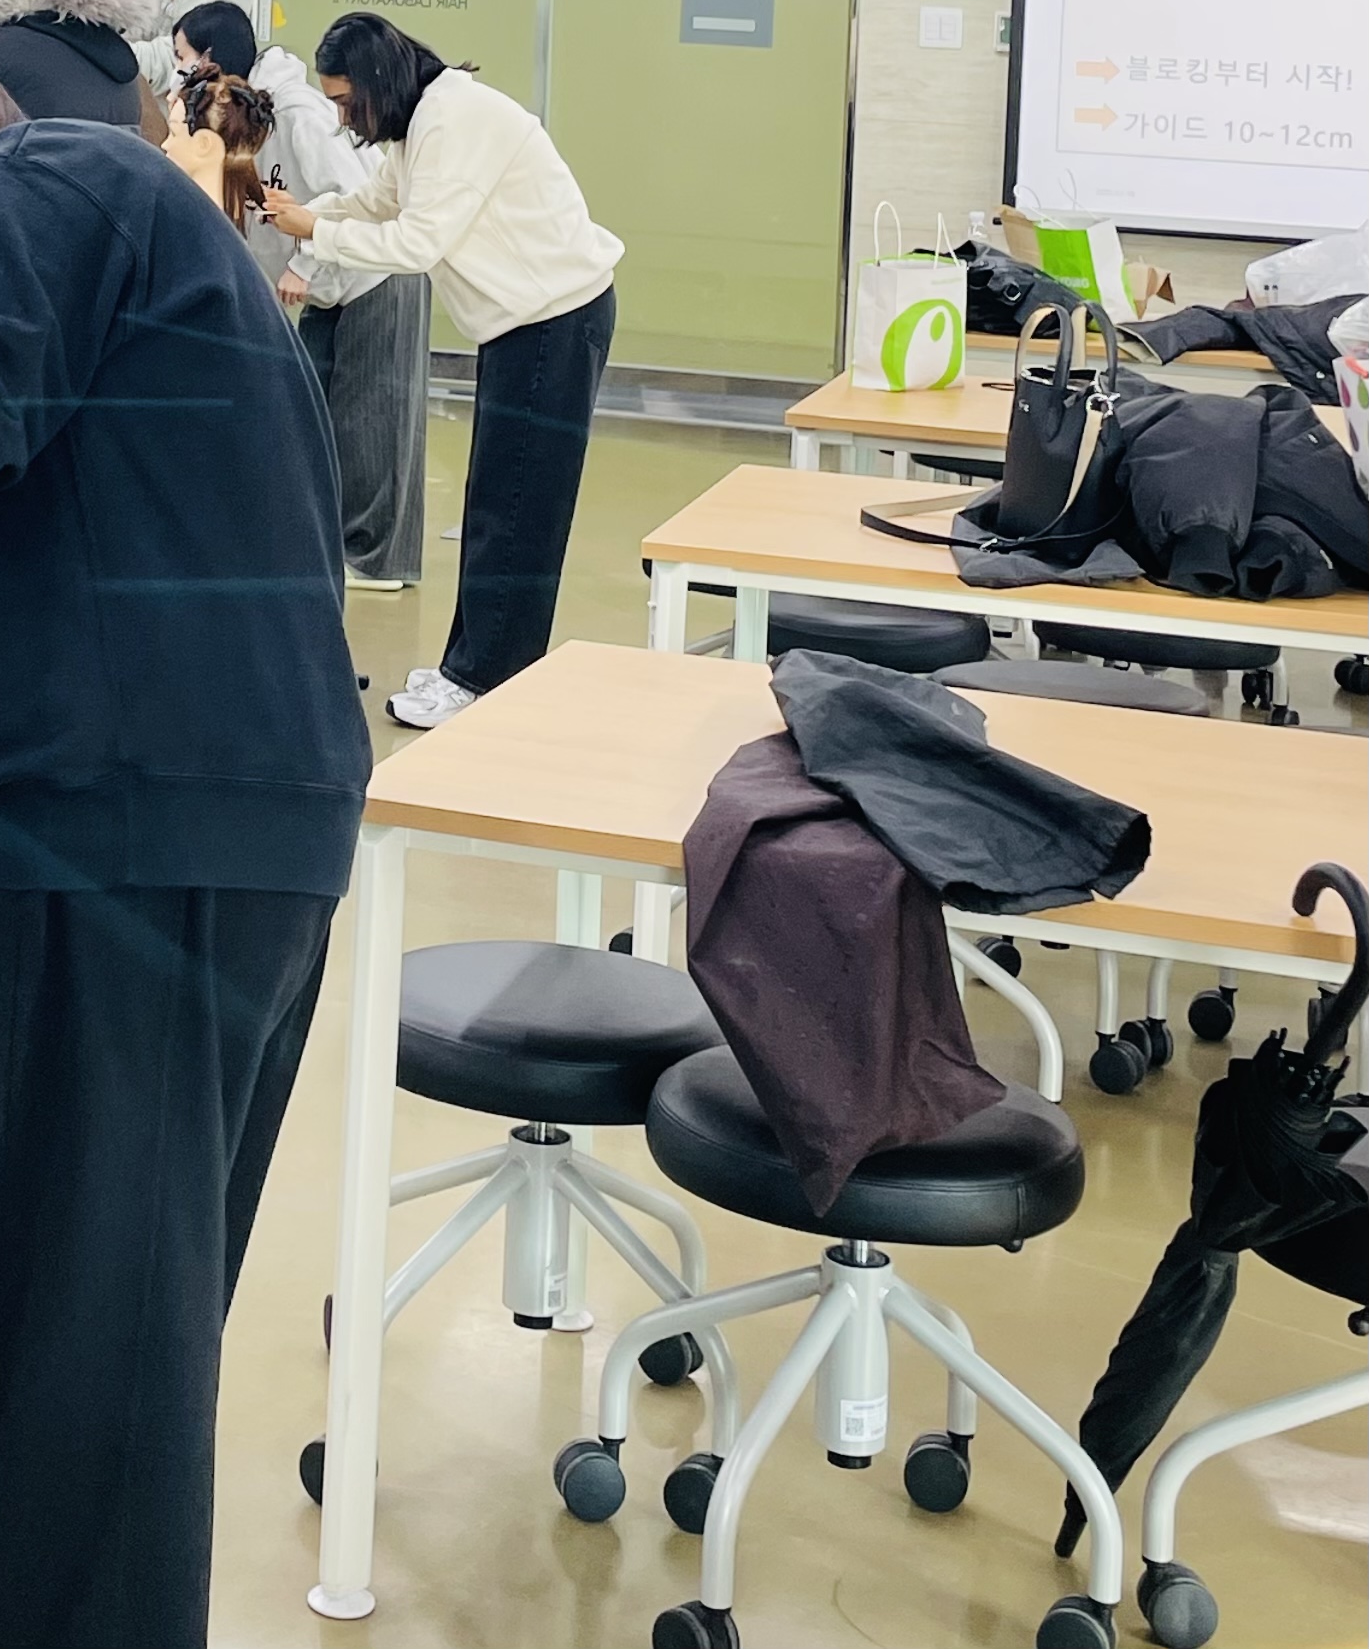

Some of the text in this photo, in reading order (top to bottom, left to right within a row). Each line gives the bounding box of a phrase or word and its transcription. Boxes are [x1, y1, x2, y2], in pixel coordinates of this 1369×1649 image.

[1126, 55, 1354, 93] 블로킹부터 시작!
[1123, 112, 1353, 149] 가이드 10~12cm
